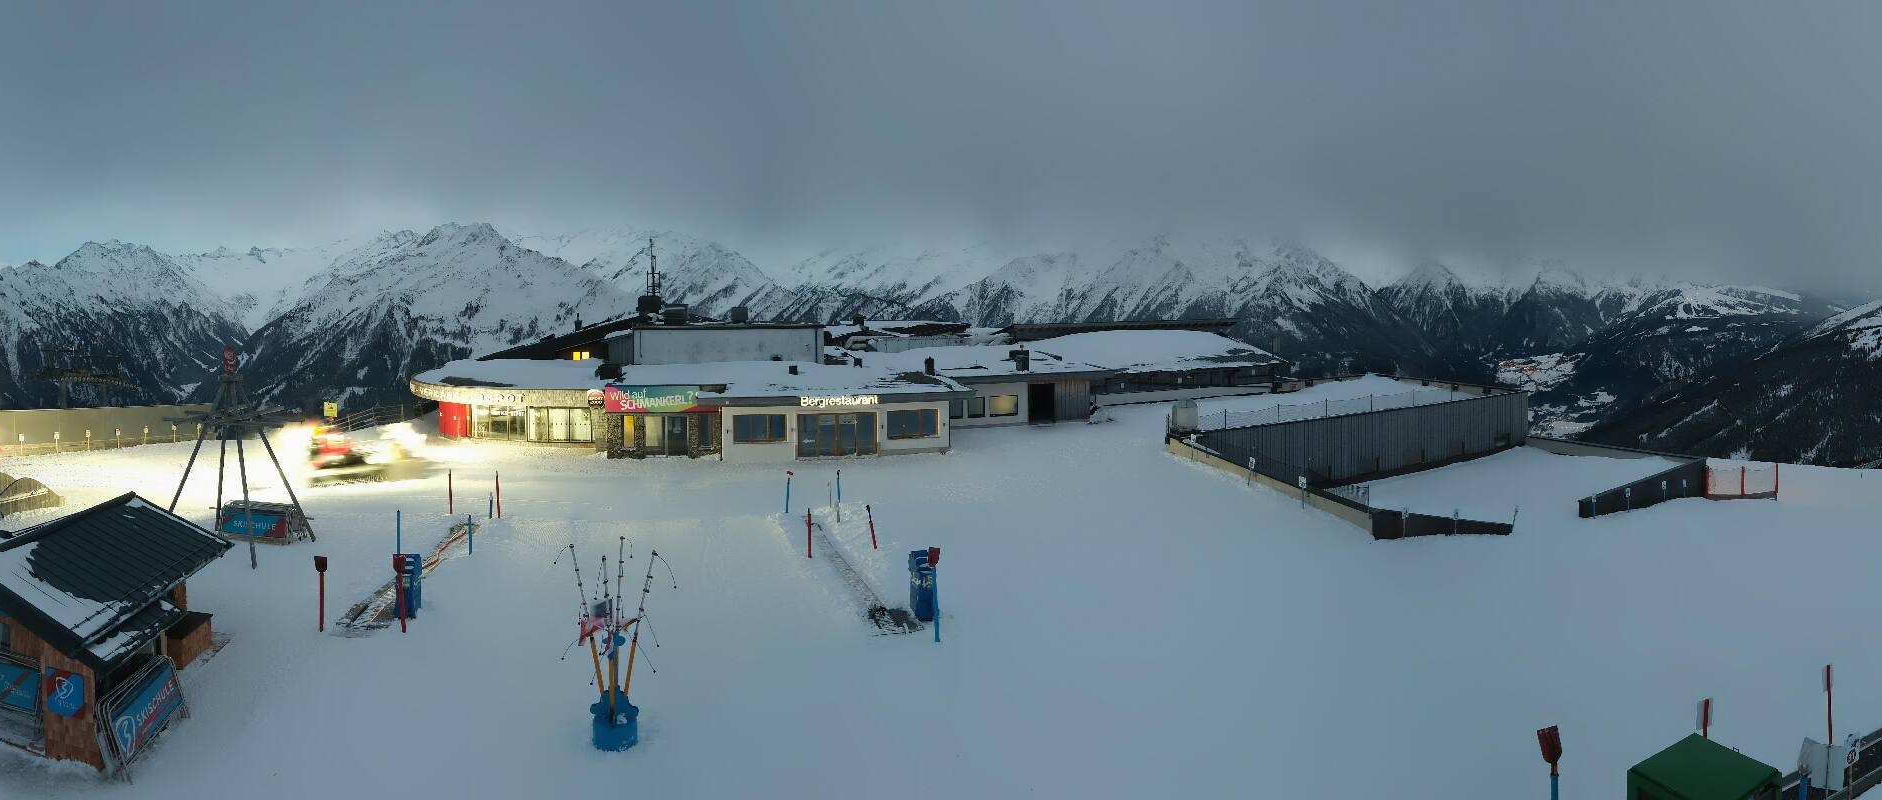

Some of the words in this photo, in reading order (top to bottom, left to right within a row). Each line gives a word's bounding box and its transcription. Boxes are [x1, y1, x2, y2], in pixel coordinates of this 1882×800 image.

[610, 389, 630, 401] Wild
[632, 387, 647, 399] auf
[800, 395, 879, 409] Bergrestaurant
[233, 520, 276, 531] SKICHULE
[136, 679, 175, 726] SKISCHULE
